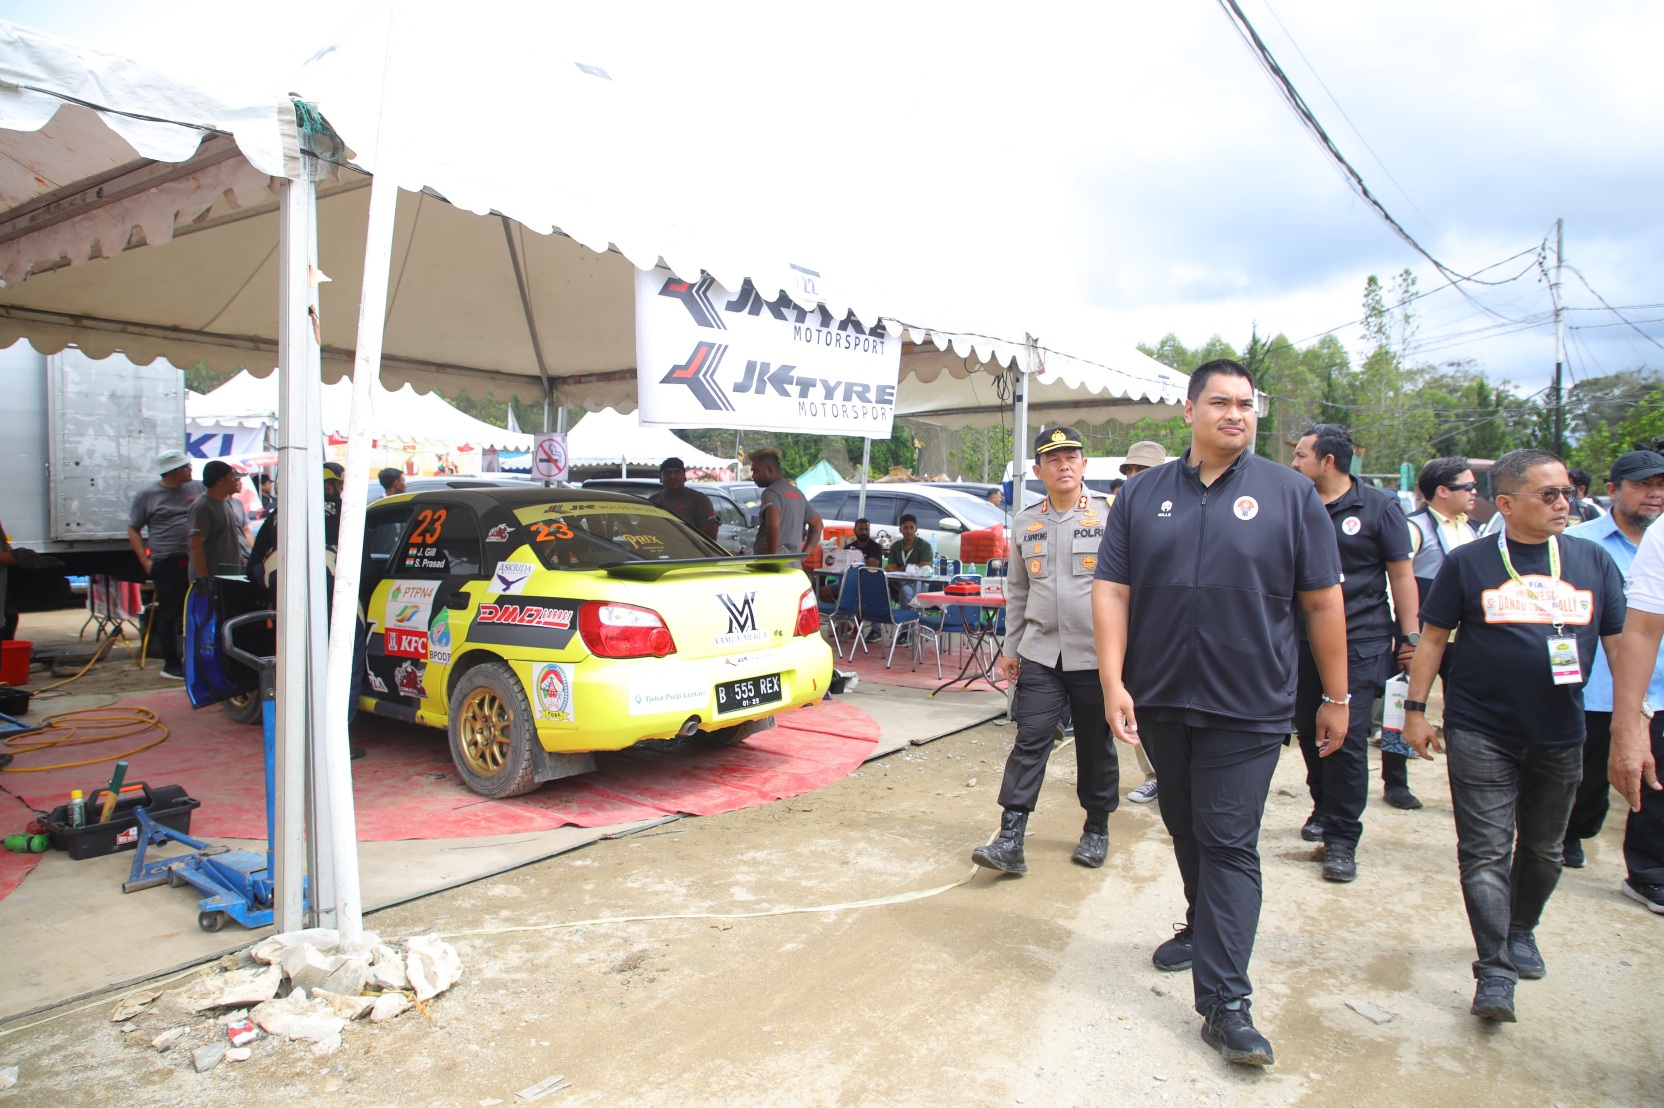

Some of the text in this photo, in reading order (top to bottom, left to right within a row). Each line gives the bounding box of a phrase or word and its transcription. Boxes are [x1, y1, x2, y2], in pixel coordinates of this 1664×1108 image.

[793, 325, 885, 356] MOTORSPORT
[408, 508, 447, 544] 23
[530, 523, 575, 542] 23
[417, 547, 437, 557] J. Gill
[414, 559, 446, 569] S. Prasad
[496, 563, 532, 575] ASKRIDA
[402, 587, 434, 599] PTPN4
[1498, 594, 1527, 612] DANAU
[400, 635, 427, 654] KFC
[645, 694, 664, 703] Toba
[665, 692, 682, 702] Pulp
[718, 675, 780, 704] B 555 REX
